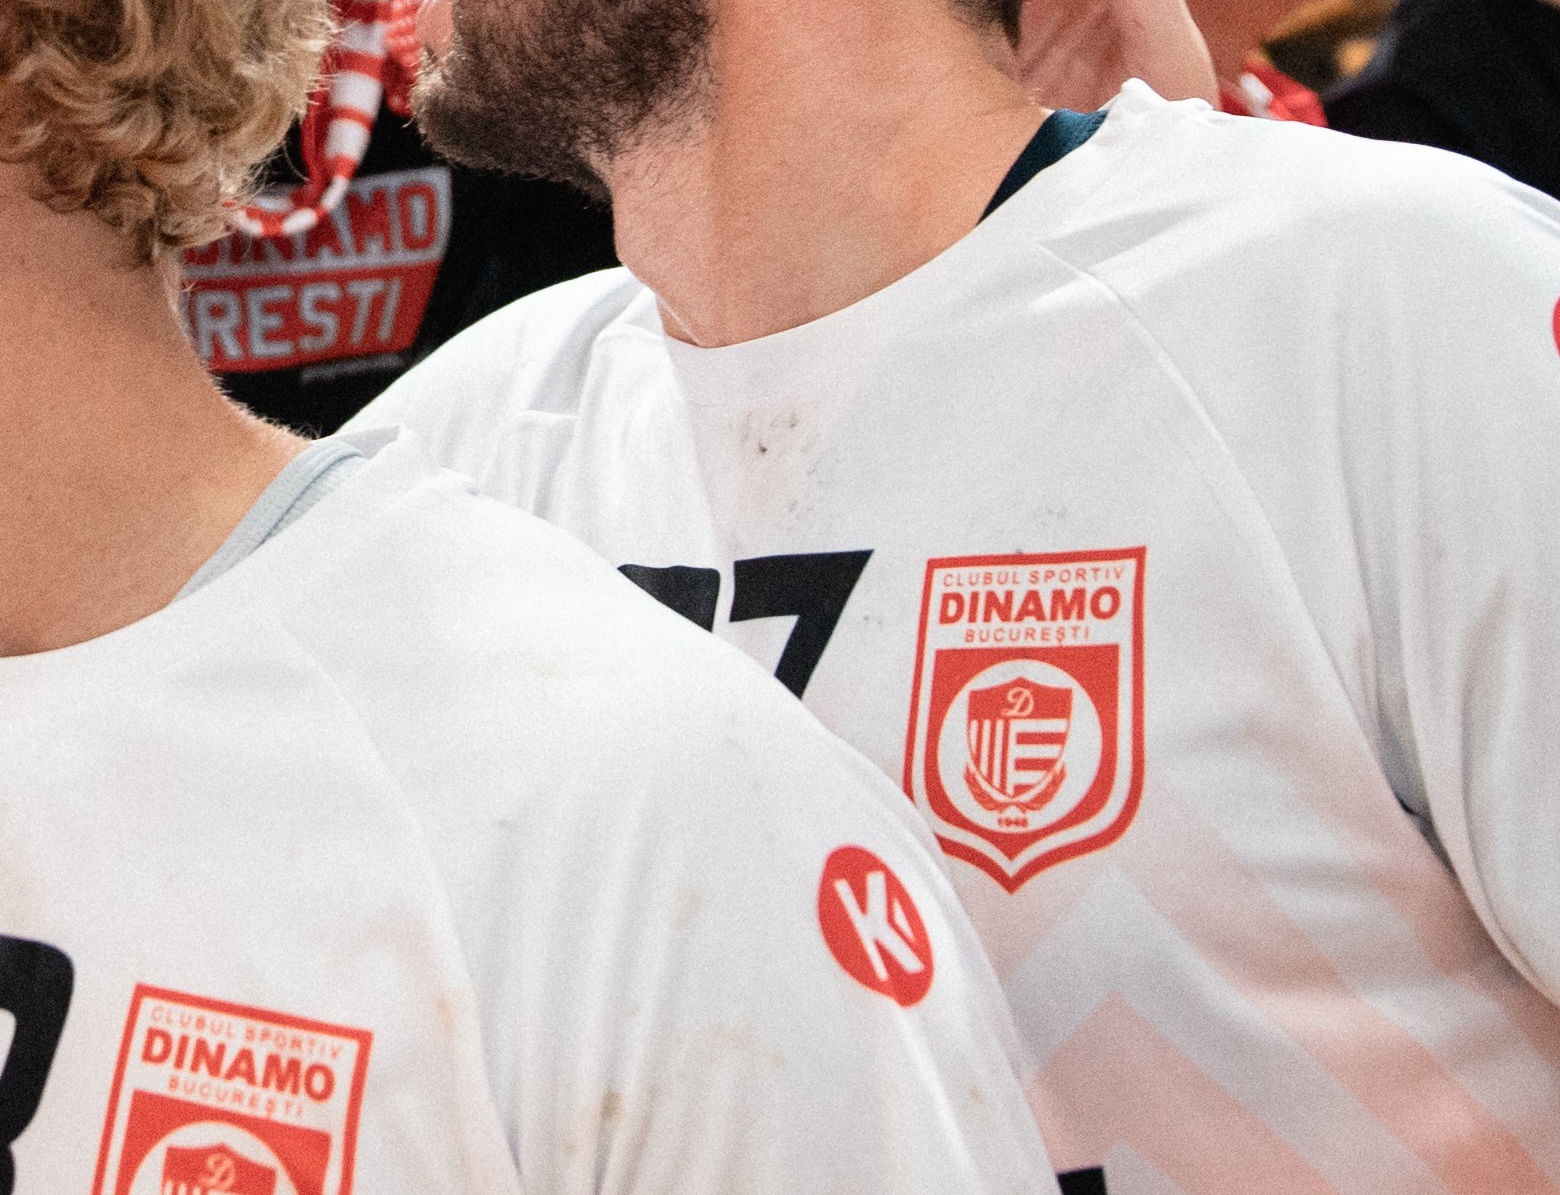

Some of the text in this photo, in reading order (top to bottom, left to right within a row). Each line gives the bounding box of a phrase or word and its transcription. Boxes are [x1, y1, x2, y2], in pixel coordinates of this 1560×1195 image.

[943, 567, 1127, 587] CLUBUL SPORTIV
[938, 585, 1122, 625] DINAMO
[150, 1004, 343, 1061] CLUBUL SPORTIV
[140, 1025, 336, 1103] DINAMO
